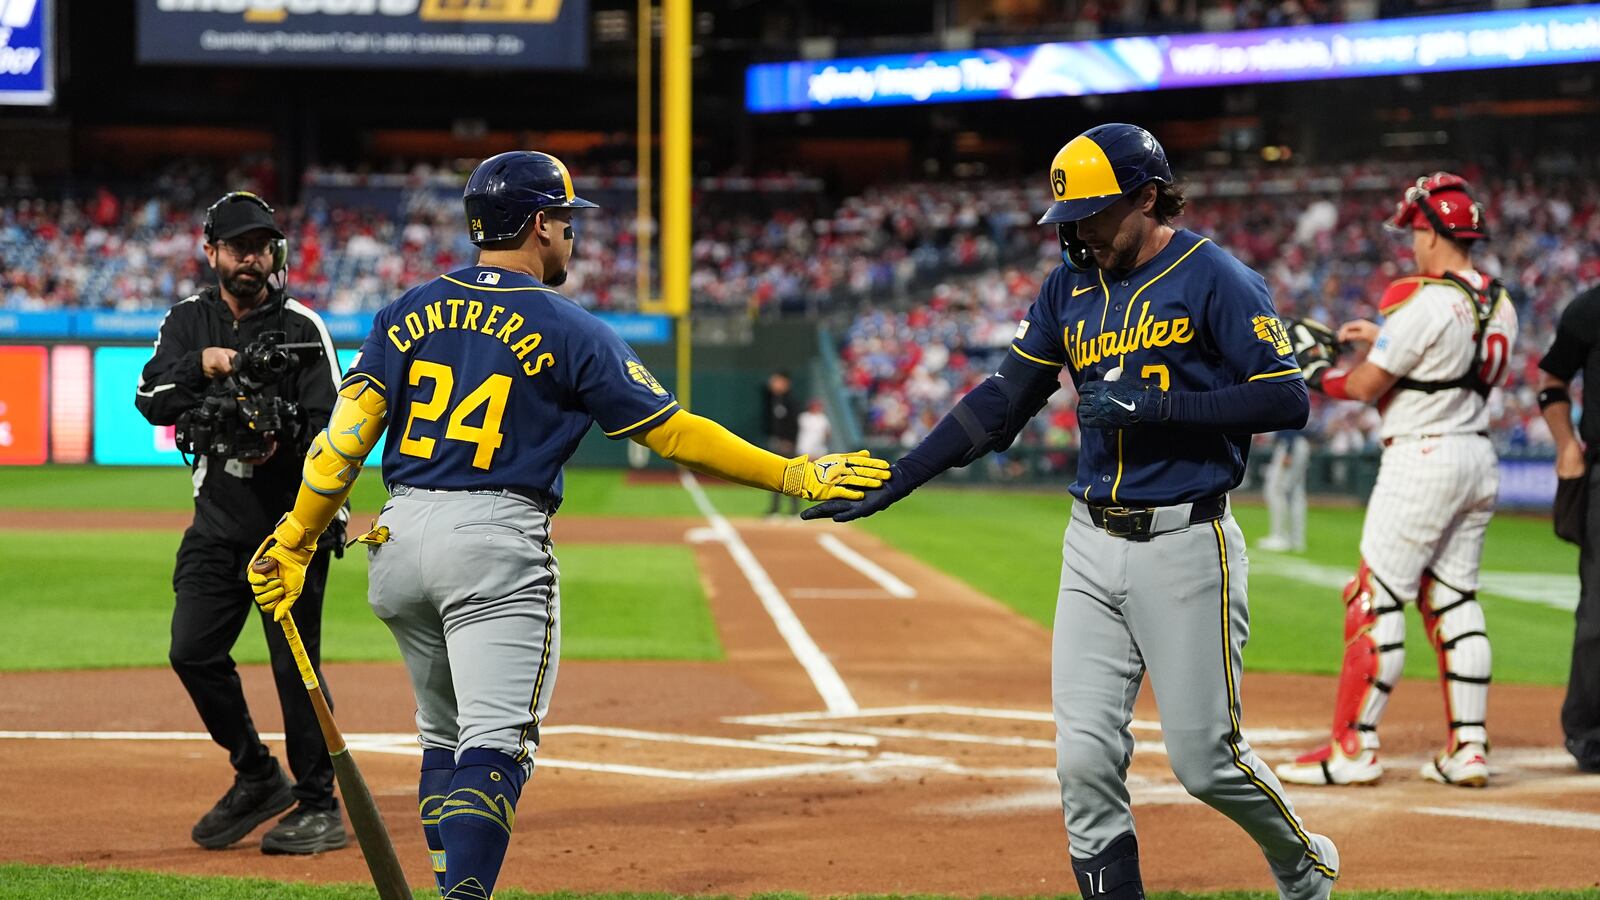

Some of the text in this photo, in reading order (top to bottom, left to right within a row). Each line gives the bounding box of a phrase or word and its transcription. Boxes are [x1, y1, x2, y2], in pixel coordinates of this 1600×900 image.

[1353, 35, 1416, 63] never
[1417, 31, 1467, 66] gets
[1468, 22, 1547, 60] caught
[876, 62, 961, 101] Imagine
[960, 58, 1012, 91] That
[471, 219, 482, 230] 24
[387, 299, 556, 376] CONTRERAS
[399, 359, 513, 471] 24
